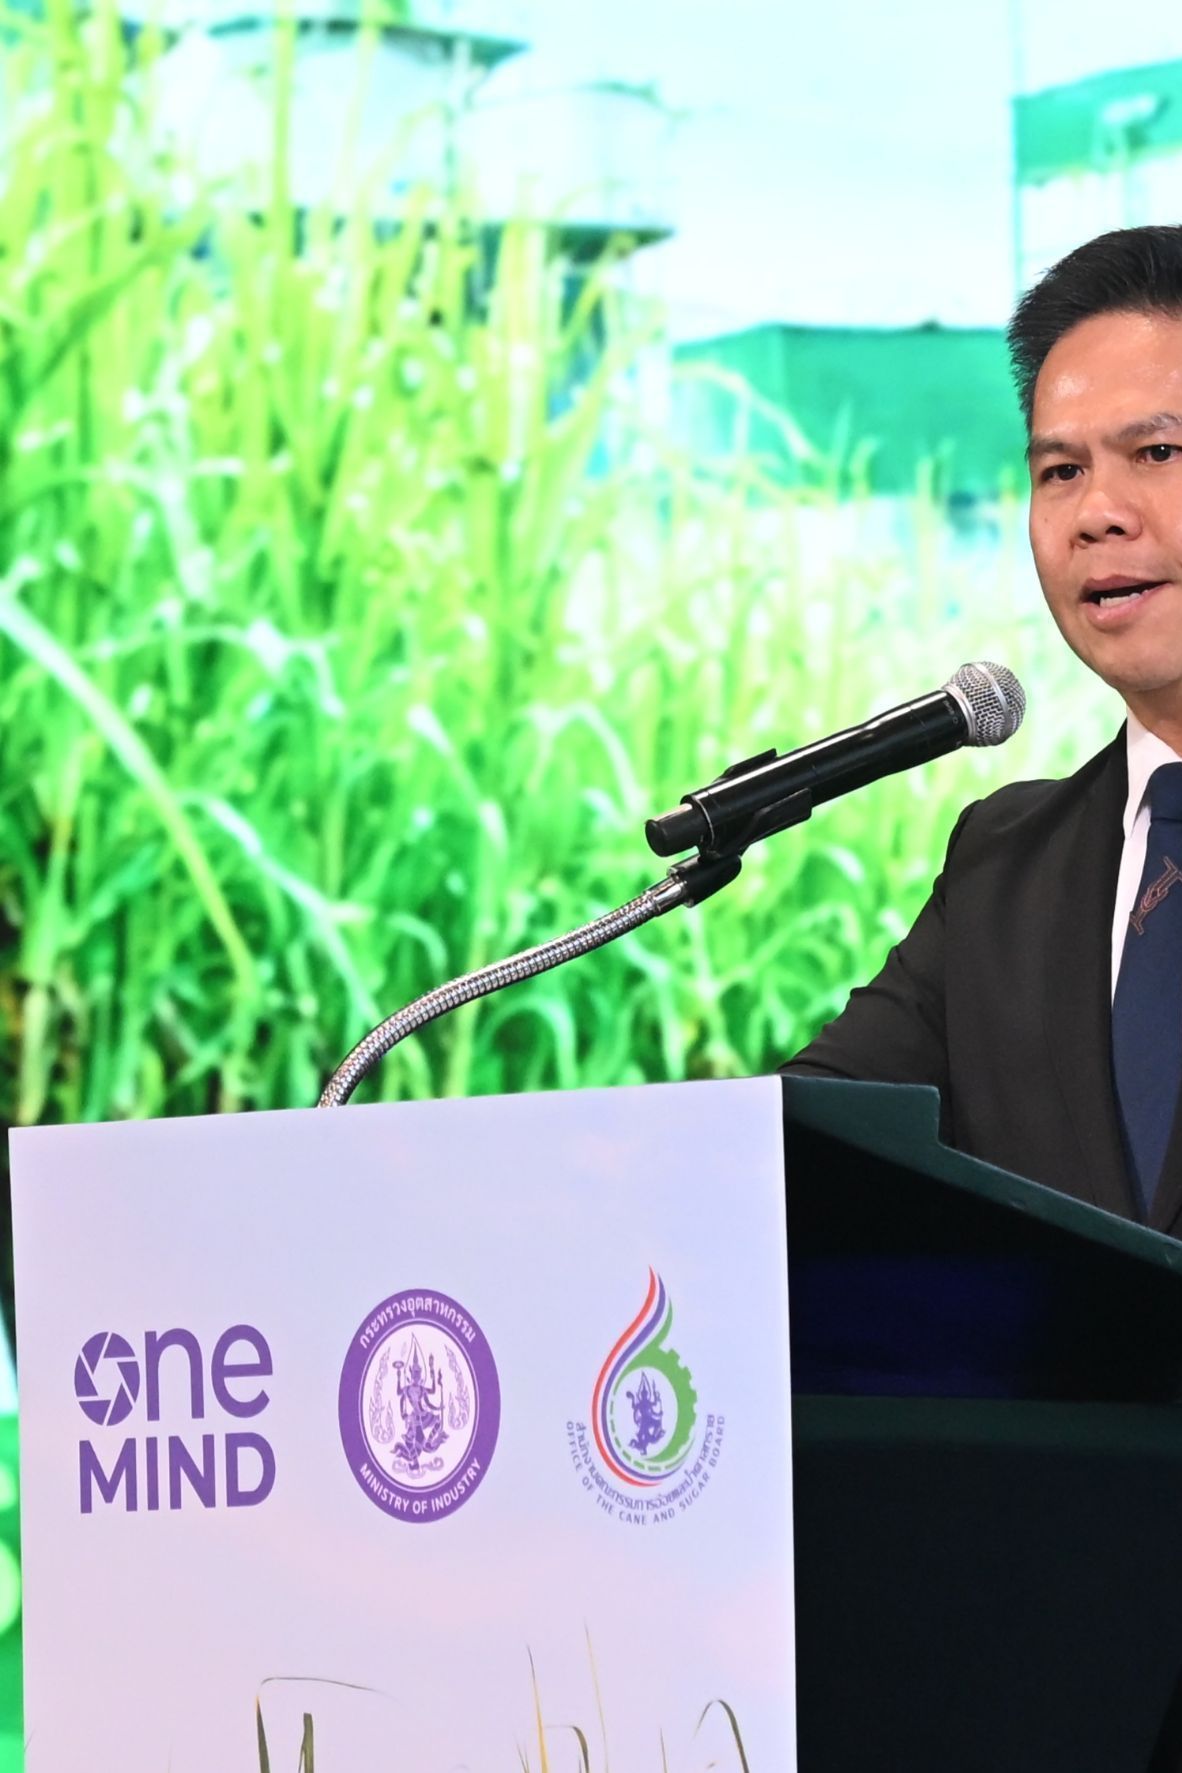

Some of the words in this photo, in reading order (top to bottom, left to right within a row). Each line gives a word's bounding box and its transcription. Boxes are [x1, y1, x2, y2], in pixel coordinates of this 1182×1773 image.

[359, 1296, 476, 1349] กระทรวงอุตสาหกรรม
[78, 1431, 277, 1515] MIND
[359, 1462, 410, 1513] MINISTRY
[412, 1500, 428, 1515] OF
[431, 1457, 481, 1513] INDUSTRY
[566, 1420, 582, 1472] OFFICE
[582, 1475, 594, 1491] OF
[596, 1493, 614, 1515] THE
[618, 1511, 646, 1526] CANE
[653, 1507, 676, 1524] AND
[678, 1471, 710, 1512] SUGAR
[708, 1415, 725, 1468] BOARD
